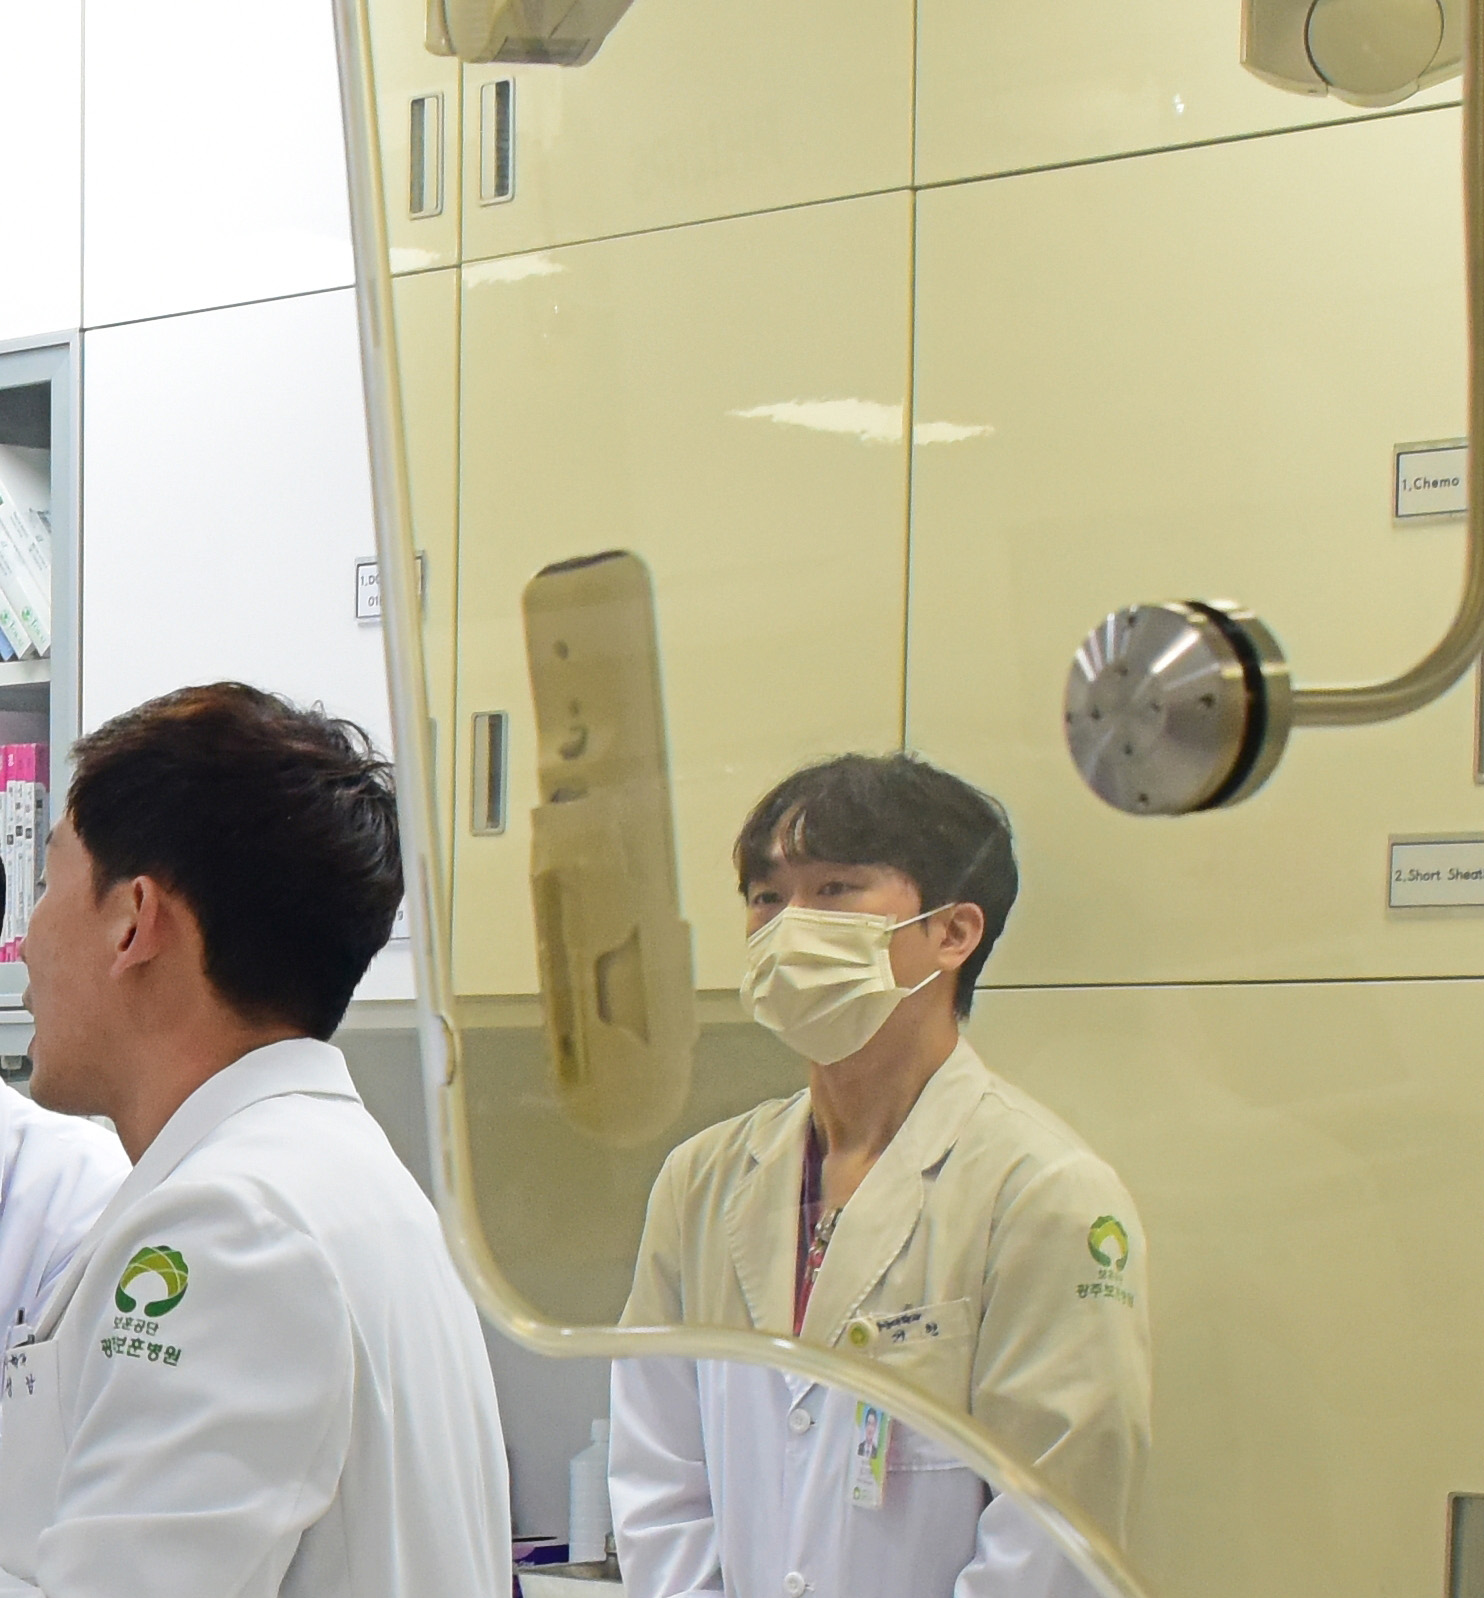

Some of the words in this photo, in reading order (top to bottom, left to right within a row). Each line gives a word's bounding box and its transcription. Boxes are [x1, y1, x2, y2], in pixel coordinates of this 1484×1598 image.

[1402, 476, 1460, 492] 1.Chemo
[1395, 868, 1442, 882] 2.Short
[1447, 867, 1484, 882] Sheat
[113, 1316, 160, 1336] 보훈공단
[100, 1336, 182, 1367] 광보훈병원
